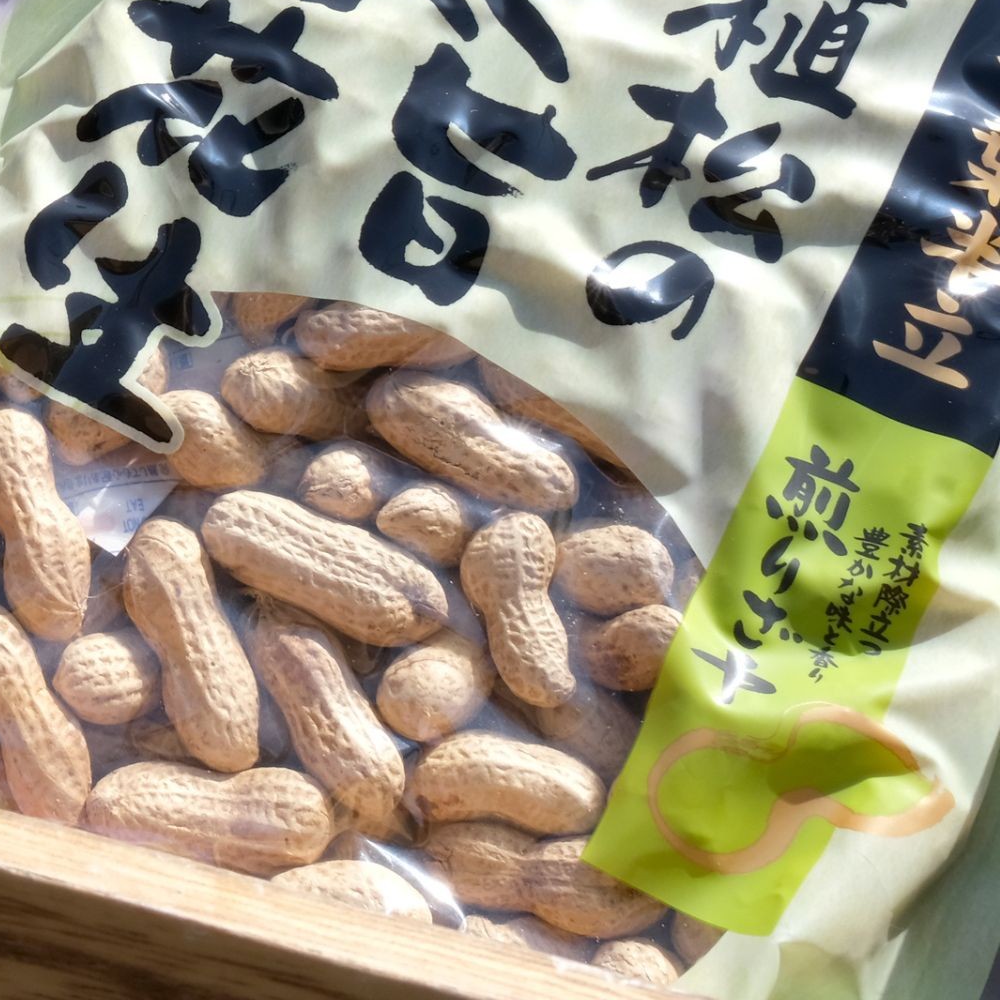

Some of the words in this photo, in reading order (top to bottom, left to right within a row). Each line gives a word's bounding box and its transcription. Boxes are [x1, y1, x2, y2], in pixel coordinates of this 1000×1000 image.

[126, 498, 145, 513] EAT
[808, 527, 891, 683] 豊かな味と香り
[859, 523, 929, 656] 素材際立つ
